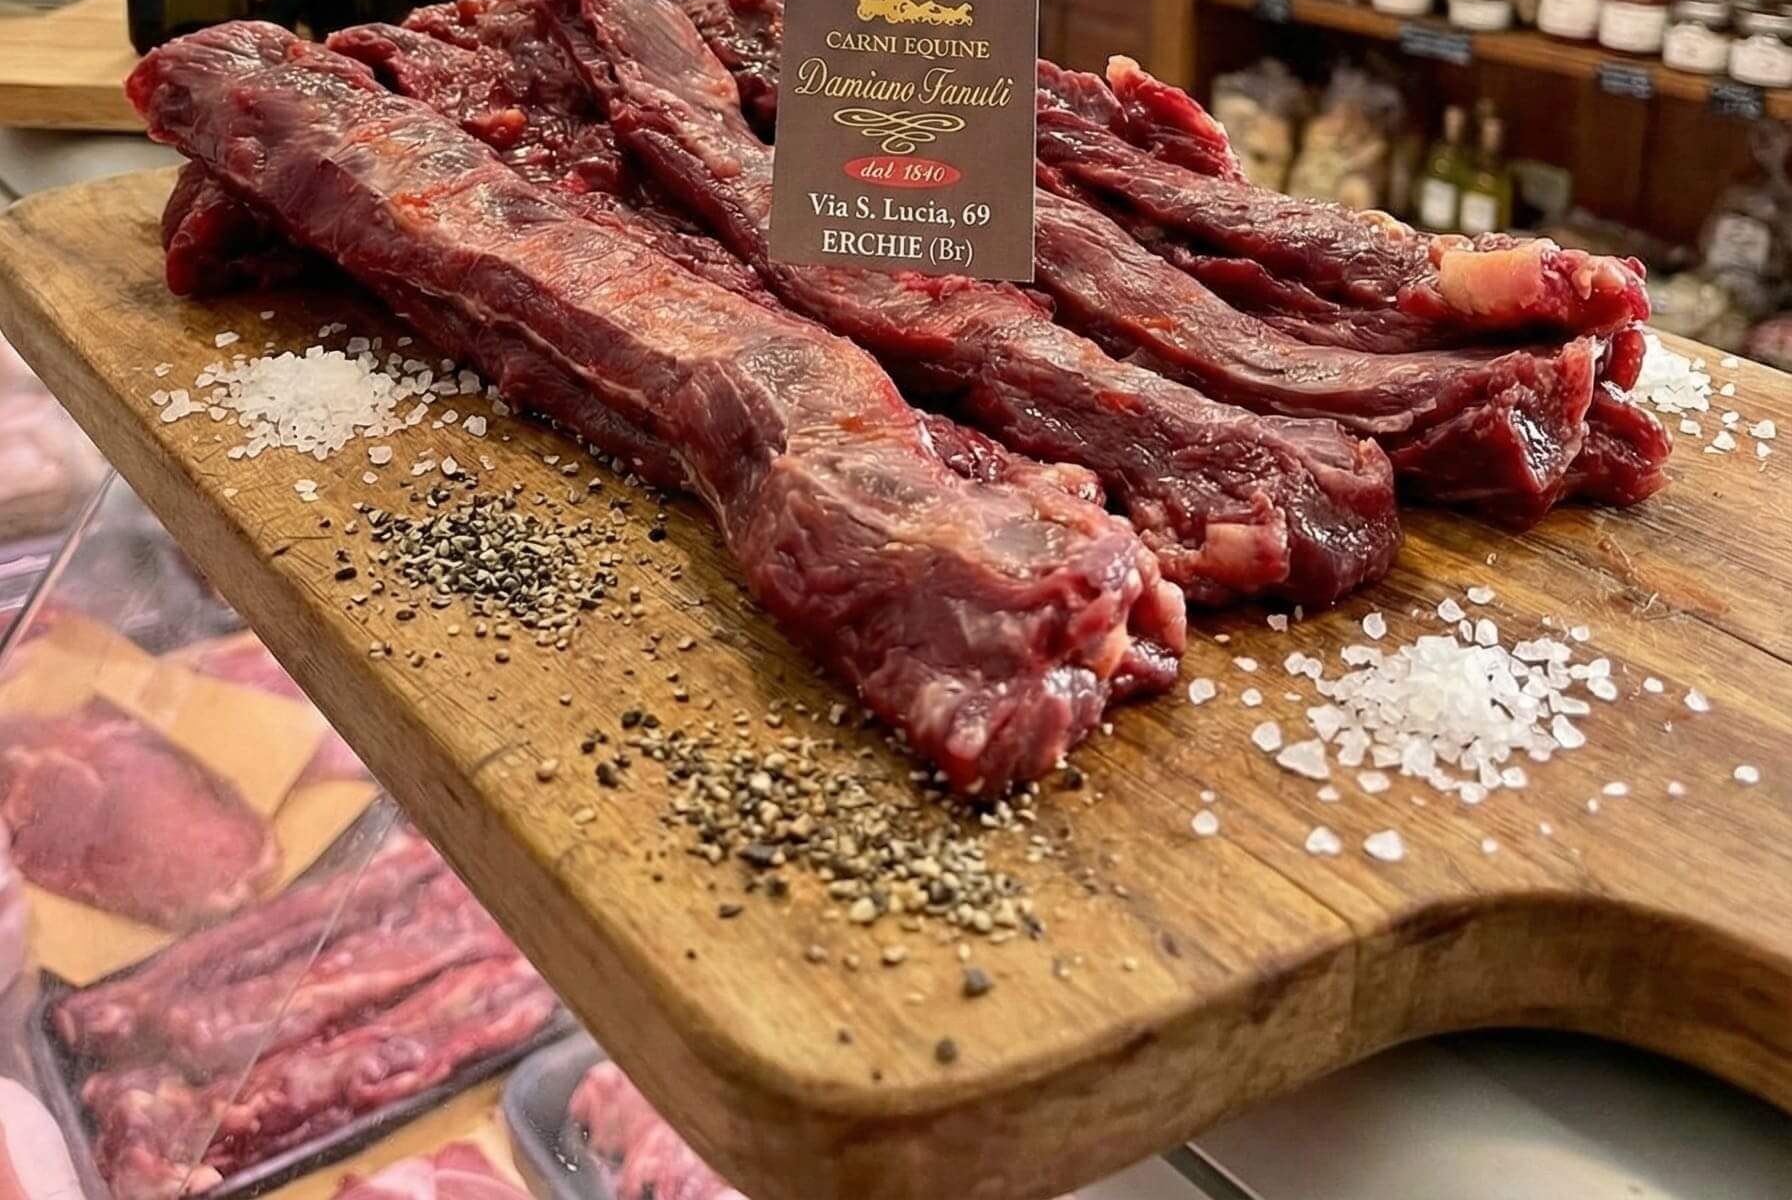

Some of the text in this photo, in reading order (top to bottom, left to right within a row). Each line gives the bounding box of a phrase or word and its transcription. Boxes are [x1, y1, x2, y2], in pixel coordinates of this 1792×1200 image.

[826, 32, 990, 60] CARNI EQUINE
[796, 58, 1014, 107] Damiano Fanuli
[860, 160, 945, 182] dal 1840
[808, 193, 991, 228] Via S. Lucia, 69
[822, 230, 974, 266] ERCHIE (Br)
